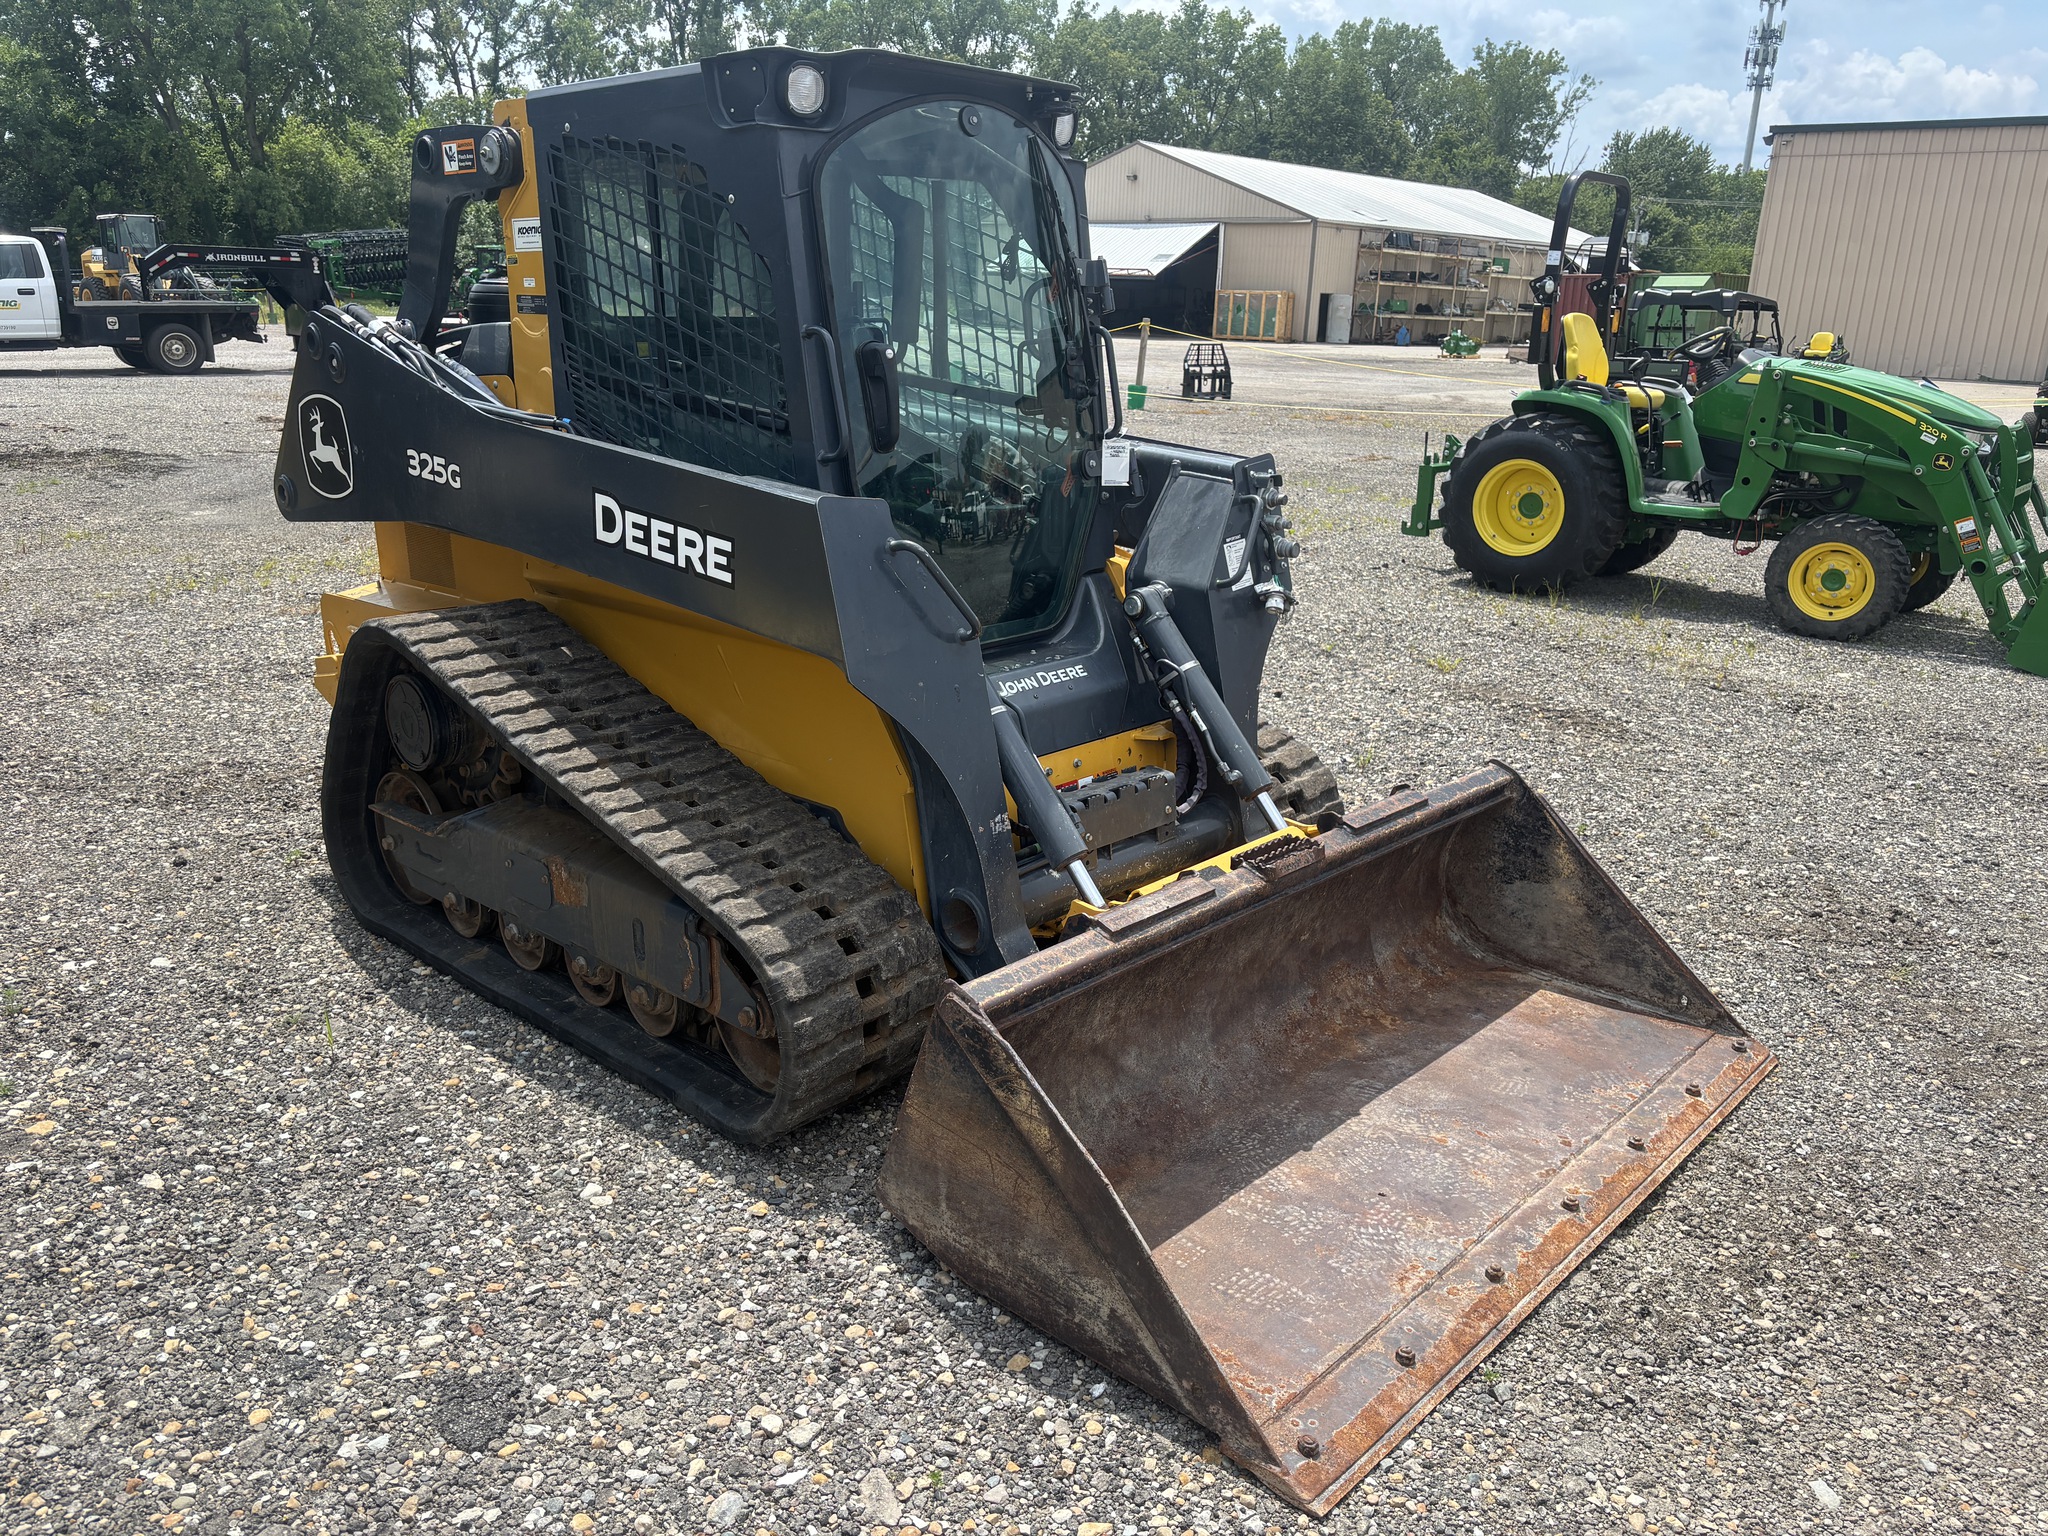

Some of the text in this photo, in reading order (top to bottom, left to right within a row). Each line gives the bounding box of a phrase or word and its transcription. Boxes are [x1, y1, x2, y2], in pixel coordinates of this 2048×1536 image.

[216, 253, 266, 262] IRONBULL
[1919, 421, 1939, 436] 320
[1940, 432, 1948, 441] R
[406, 448, 462, 490] 325G
[594, 492, 733, 583] DEERE
[998, 664, 1088, 697] JOHN DEERE
